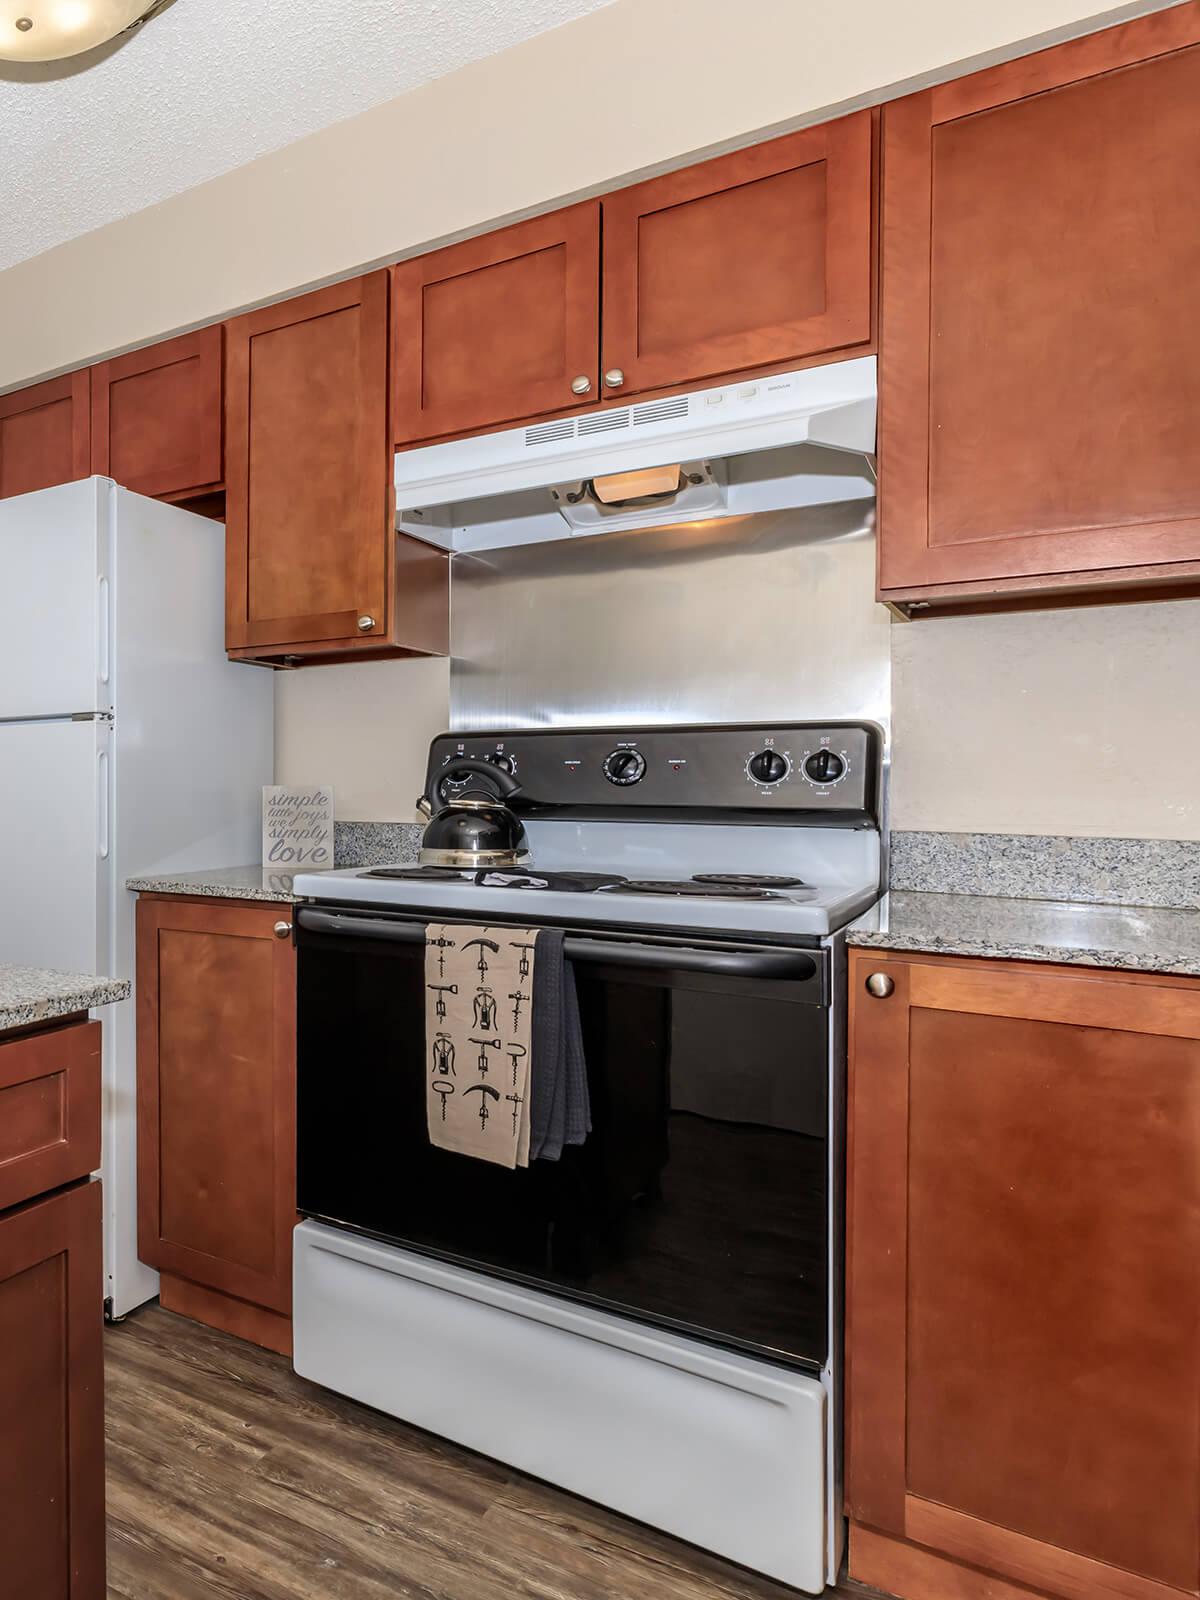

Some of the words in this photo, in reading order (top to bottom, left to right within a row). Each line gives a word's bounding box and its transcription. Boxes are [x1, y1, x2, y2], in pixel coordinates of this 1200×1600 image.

[268, 791, 329, 809] simple
[268, 808, 293, 817] little
[288, 809, 330, 826] joys
[268, 819, 288, 827] we
[268, 825, 329, 847] simply
[268, 838, 329, 863] love
